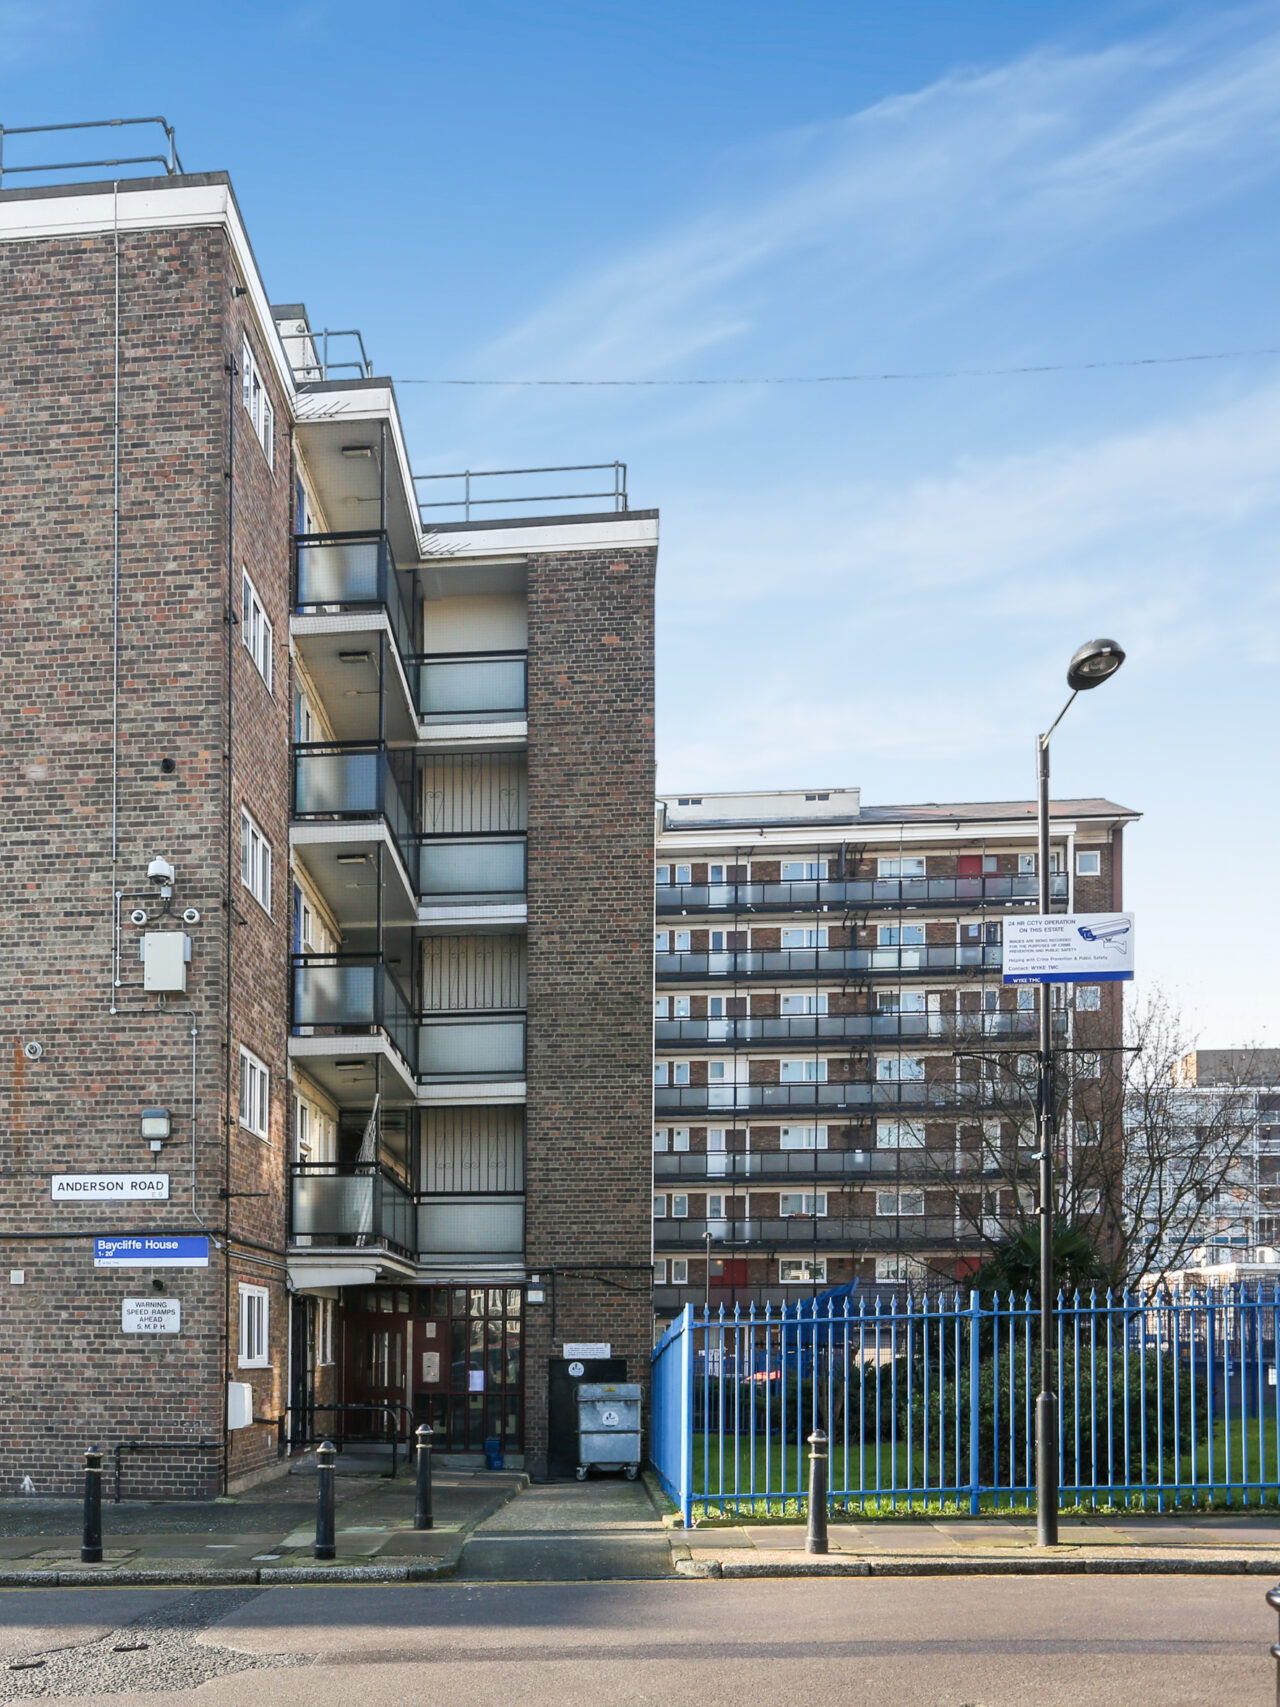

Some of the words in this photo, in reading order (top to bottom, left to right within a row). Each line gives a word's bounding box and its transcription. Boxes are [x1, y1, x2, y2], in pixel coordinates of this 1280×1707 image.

[57, 1181, 124, 1192] ANDERSON
[130, 1180, 164, 1191] ROAD
[97, 1239, 142, 1252] Baycliffe
[145, 1239, 179, 1250] House
